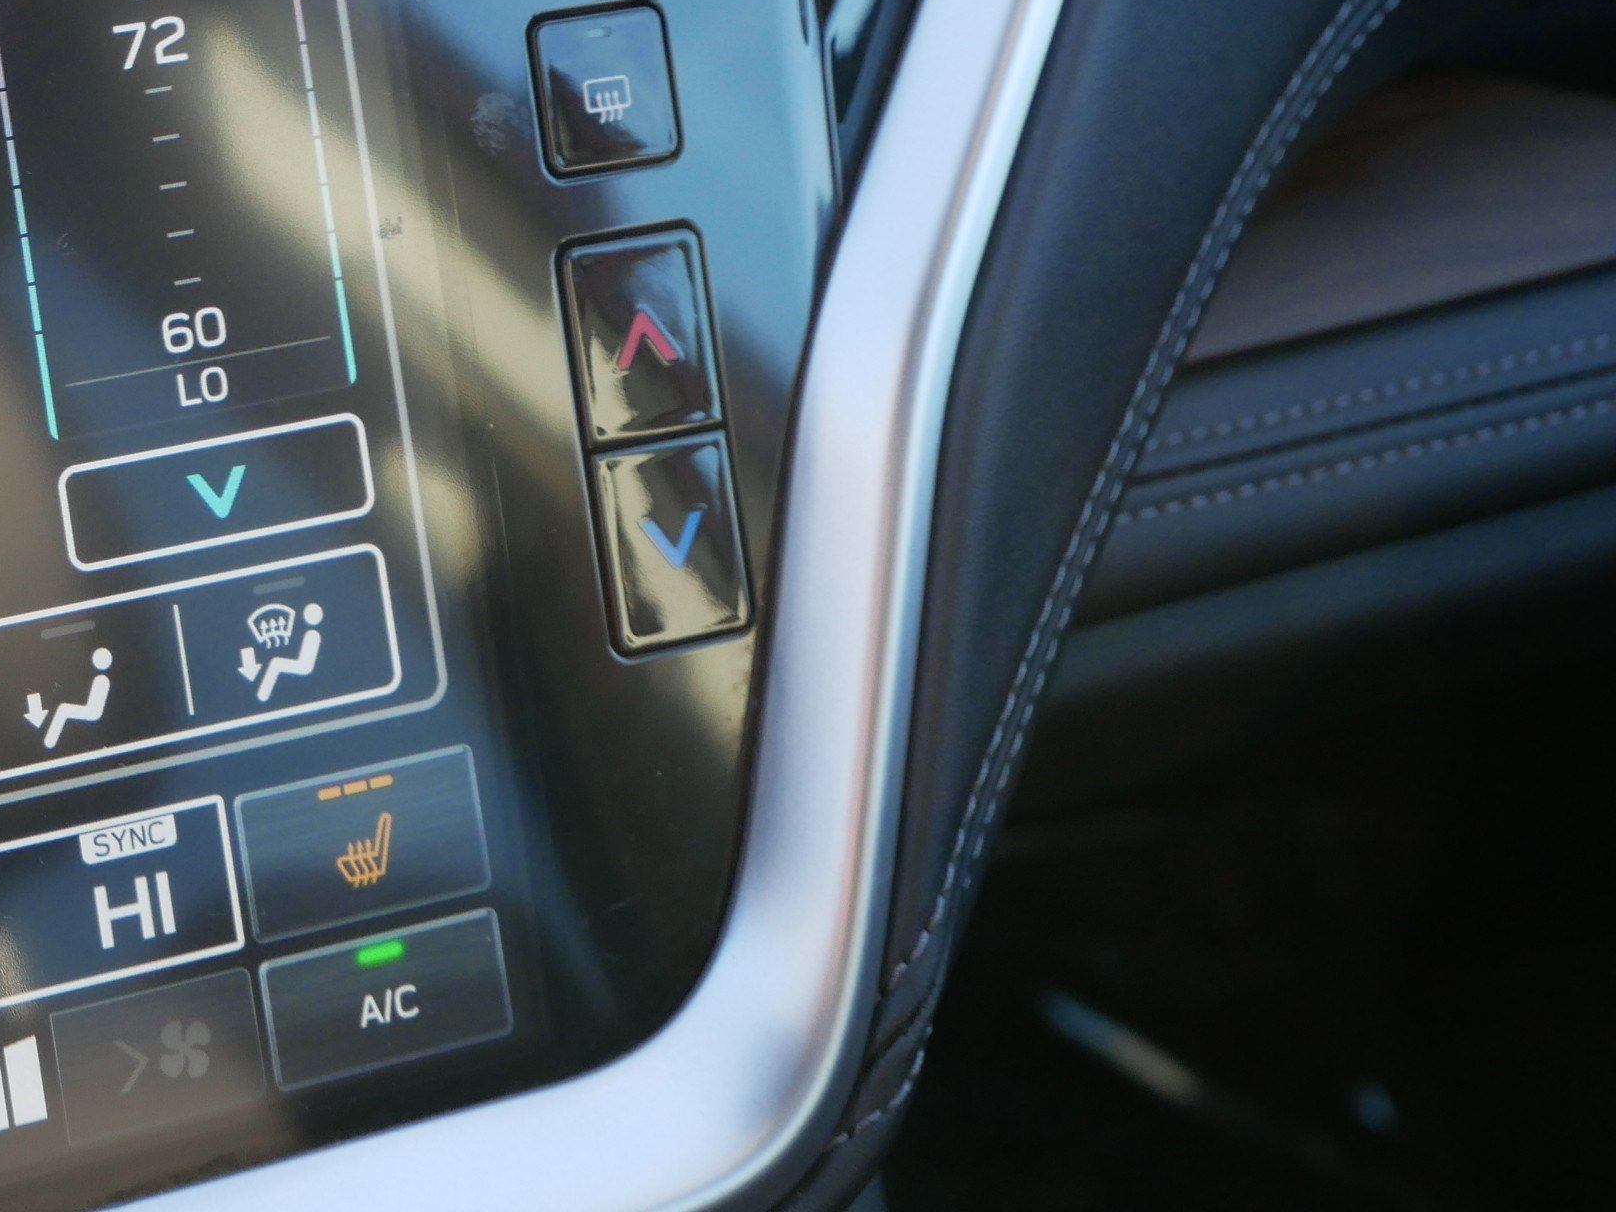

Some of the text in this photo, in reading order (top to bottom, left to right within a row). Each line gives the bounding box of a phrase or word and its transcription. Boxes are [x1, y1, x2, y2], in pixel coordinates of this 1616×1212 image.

[112, 15, 190, 70] 72
[161, 306, 227, 354] 60
[176, 366, 229, 407] LO
[92, 822, 168, 857] SYNC
[93, 871, 177, 950] HI
[360, 984, 420, 1028] A/C
